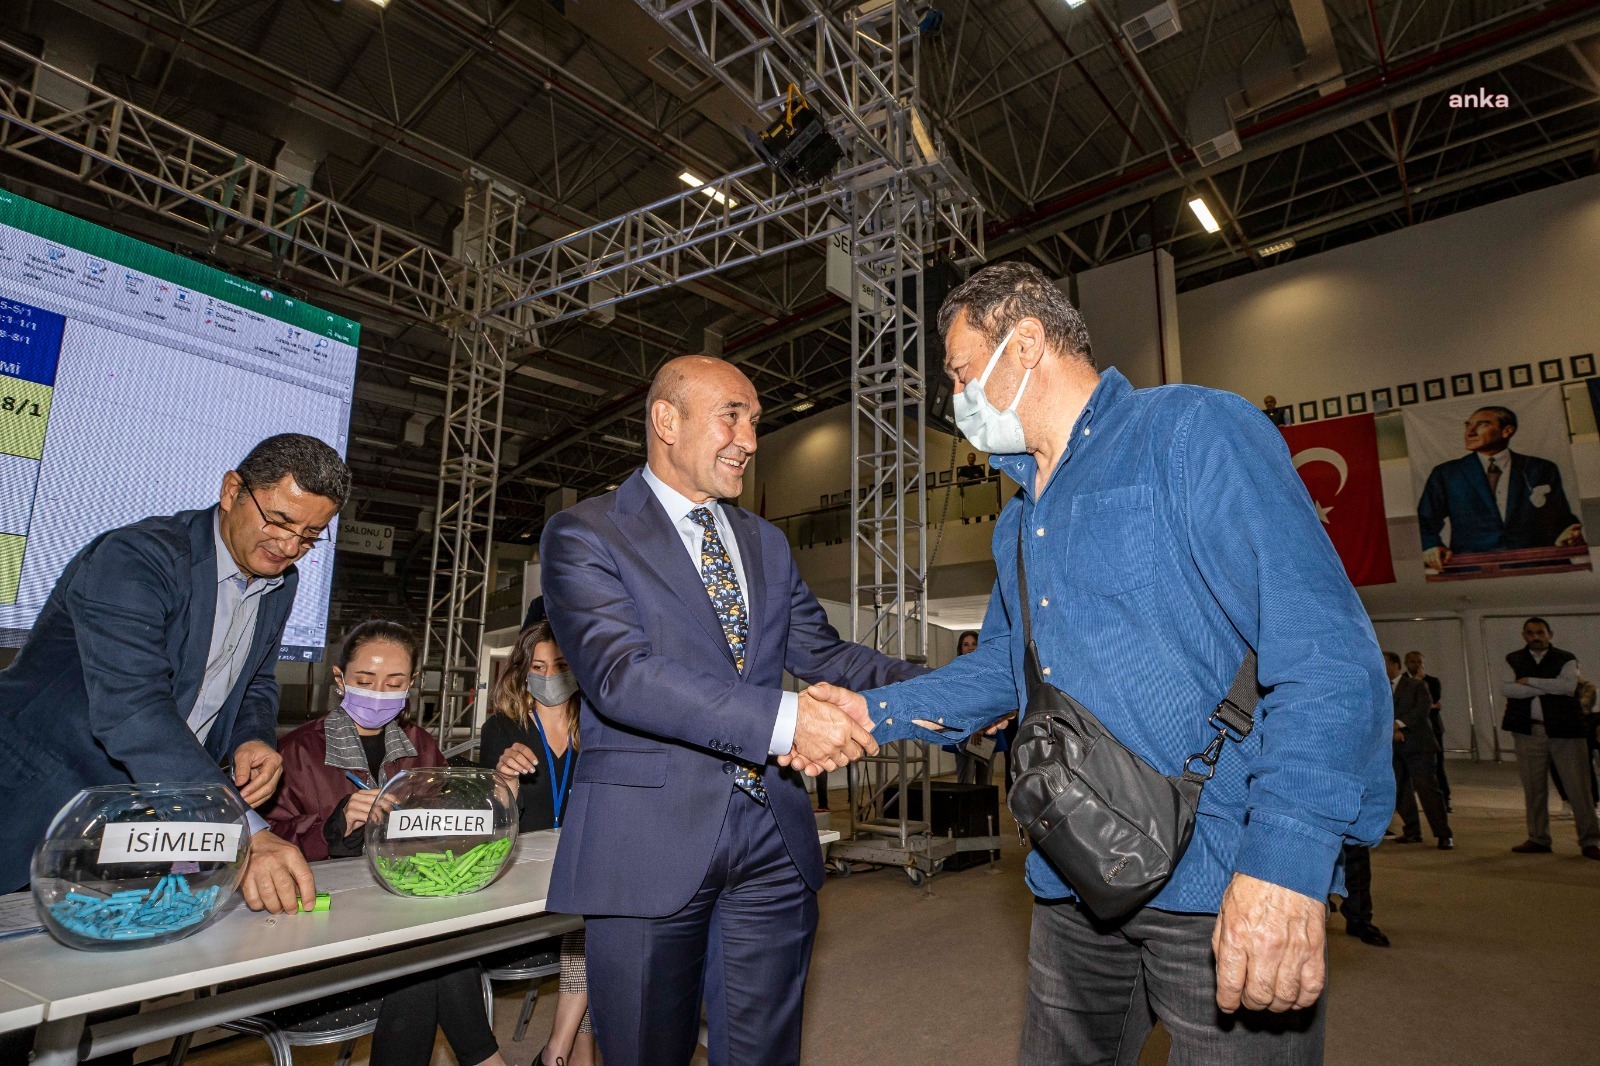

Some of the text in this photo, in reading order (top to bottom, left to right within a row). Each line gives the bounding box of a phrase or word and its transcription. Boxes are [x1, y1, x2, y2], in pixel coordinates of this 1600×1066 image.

[344, 525, 380, 537] SALONU
[384, 527, 392, 539] D
[365, 540, 371, 548] D
[399, 811, 485, 832] DAİRELER
[127, 827, 225, 853] İSİMLER
